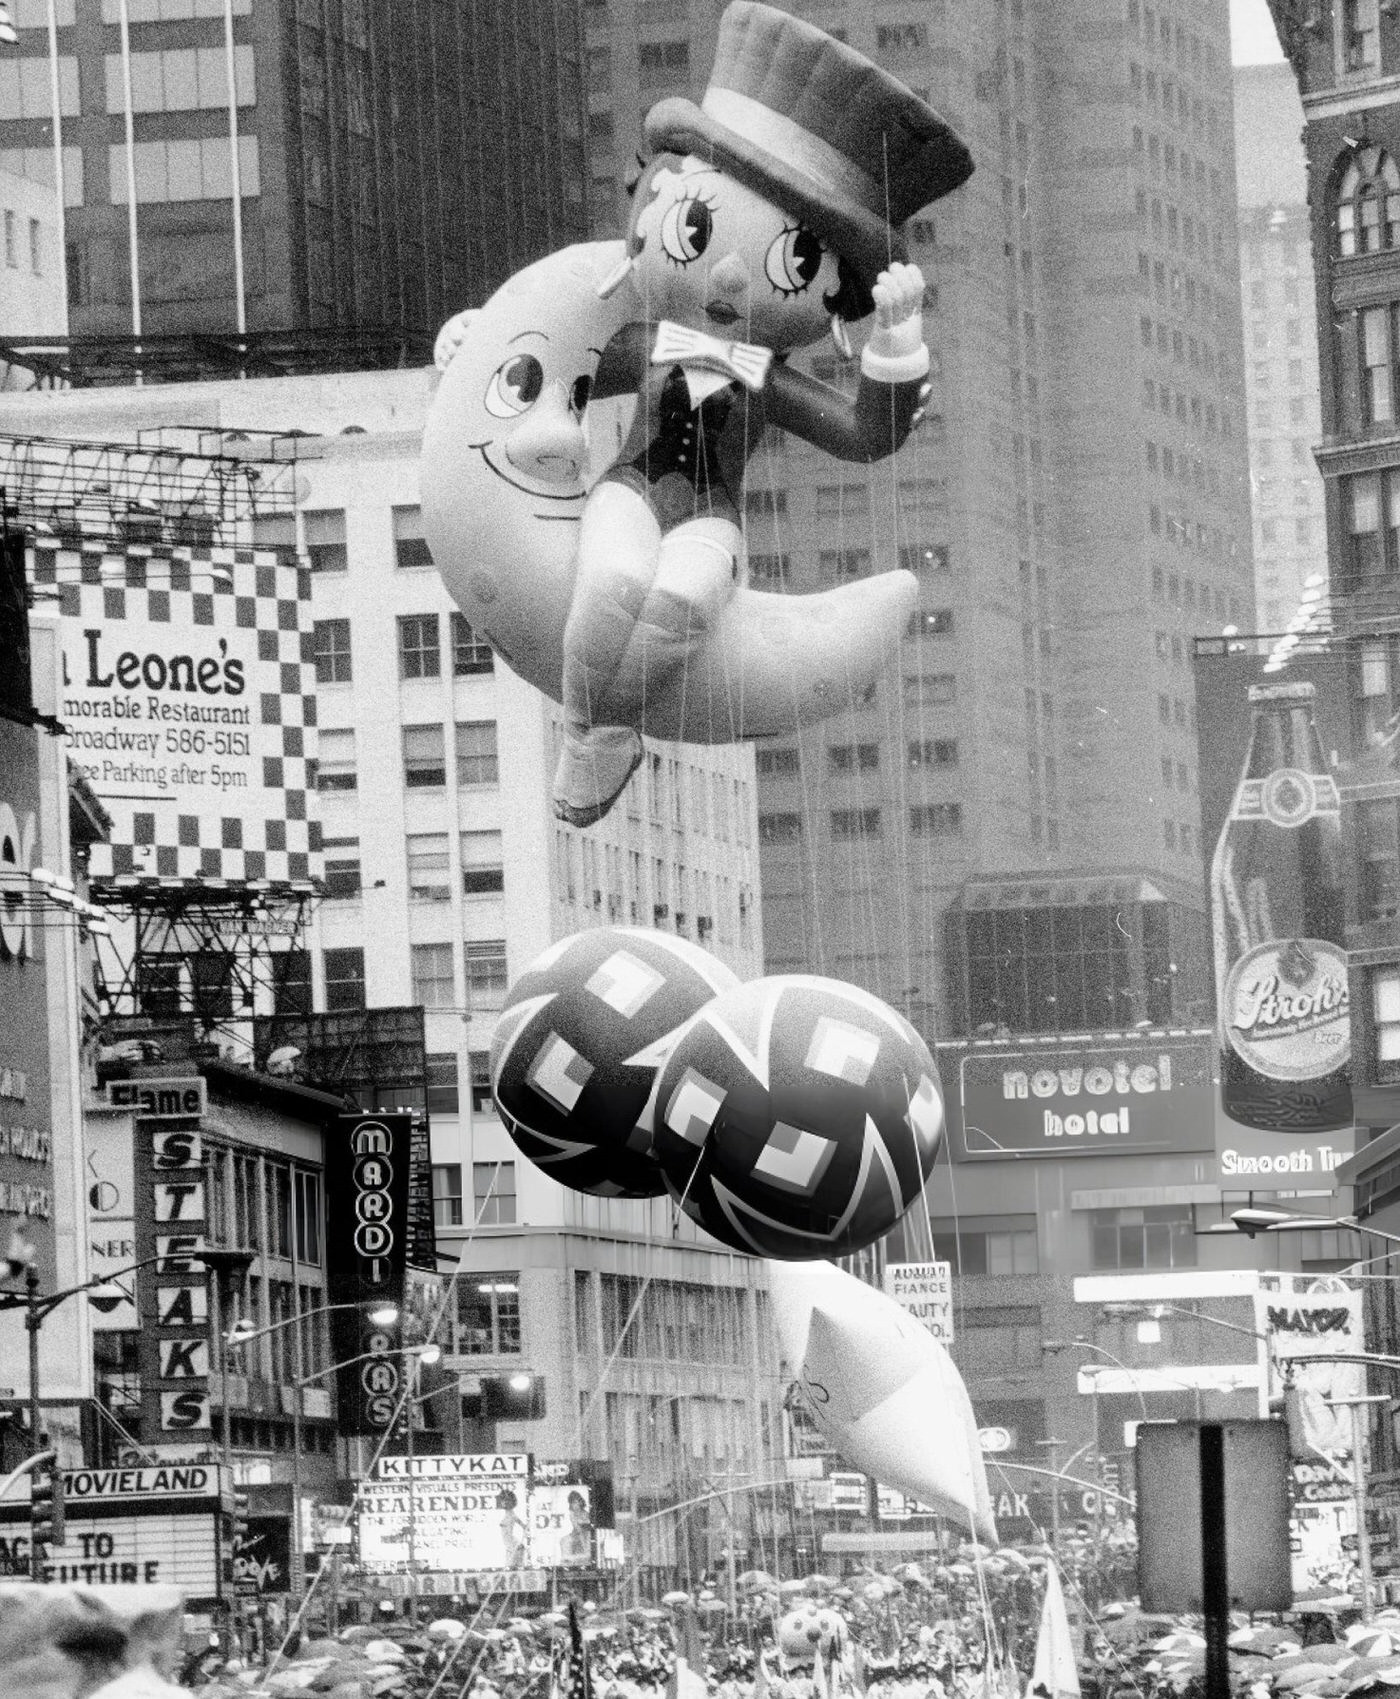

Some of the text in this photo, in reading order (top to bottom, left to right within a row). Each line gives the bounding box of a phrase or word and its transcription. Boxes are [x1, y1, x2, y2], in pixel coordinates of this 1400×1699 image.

[83, 629, 245, 695] Leone's
[147, 696, 250, 724] Restaurant
[166, 728, 250, 756] 586-5151
[102, 760, 168, 789] Parking
[171, 763, 206, 785] after
[211, 764, 248, 791] 5pm
[1003, 1055, 1172, 1100] novotel
[1043, 1107, 1130, 1137] hotel
[1221, 1149, 1313, 1175] Smooth
[356, 1128, 388, 1284] MARDI
[157, 1132, 207, 1428] STEAKS
[78, 1532, 114, 1559] TO
